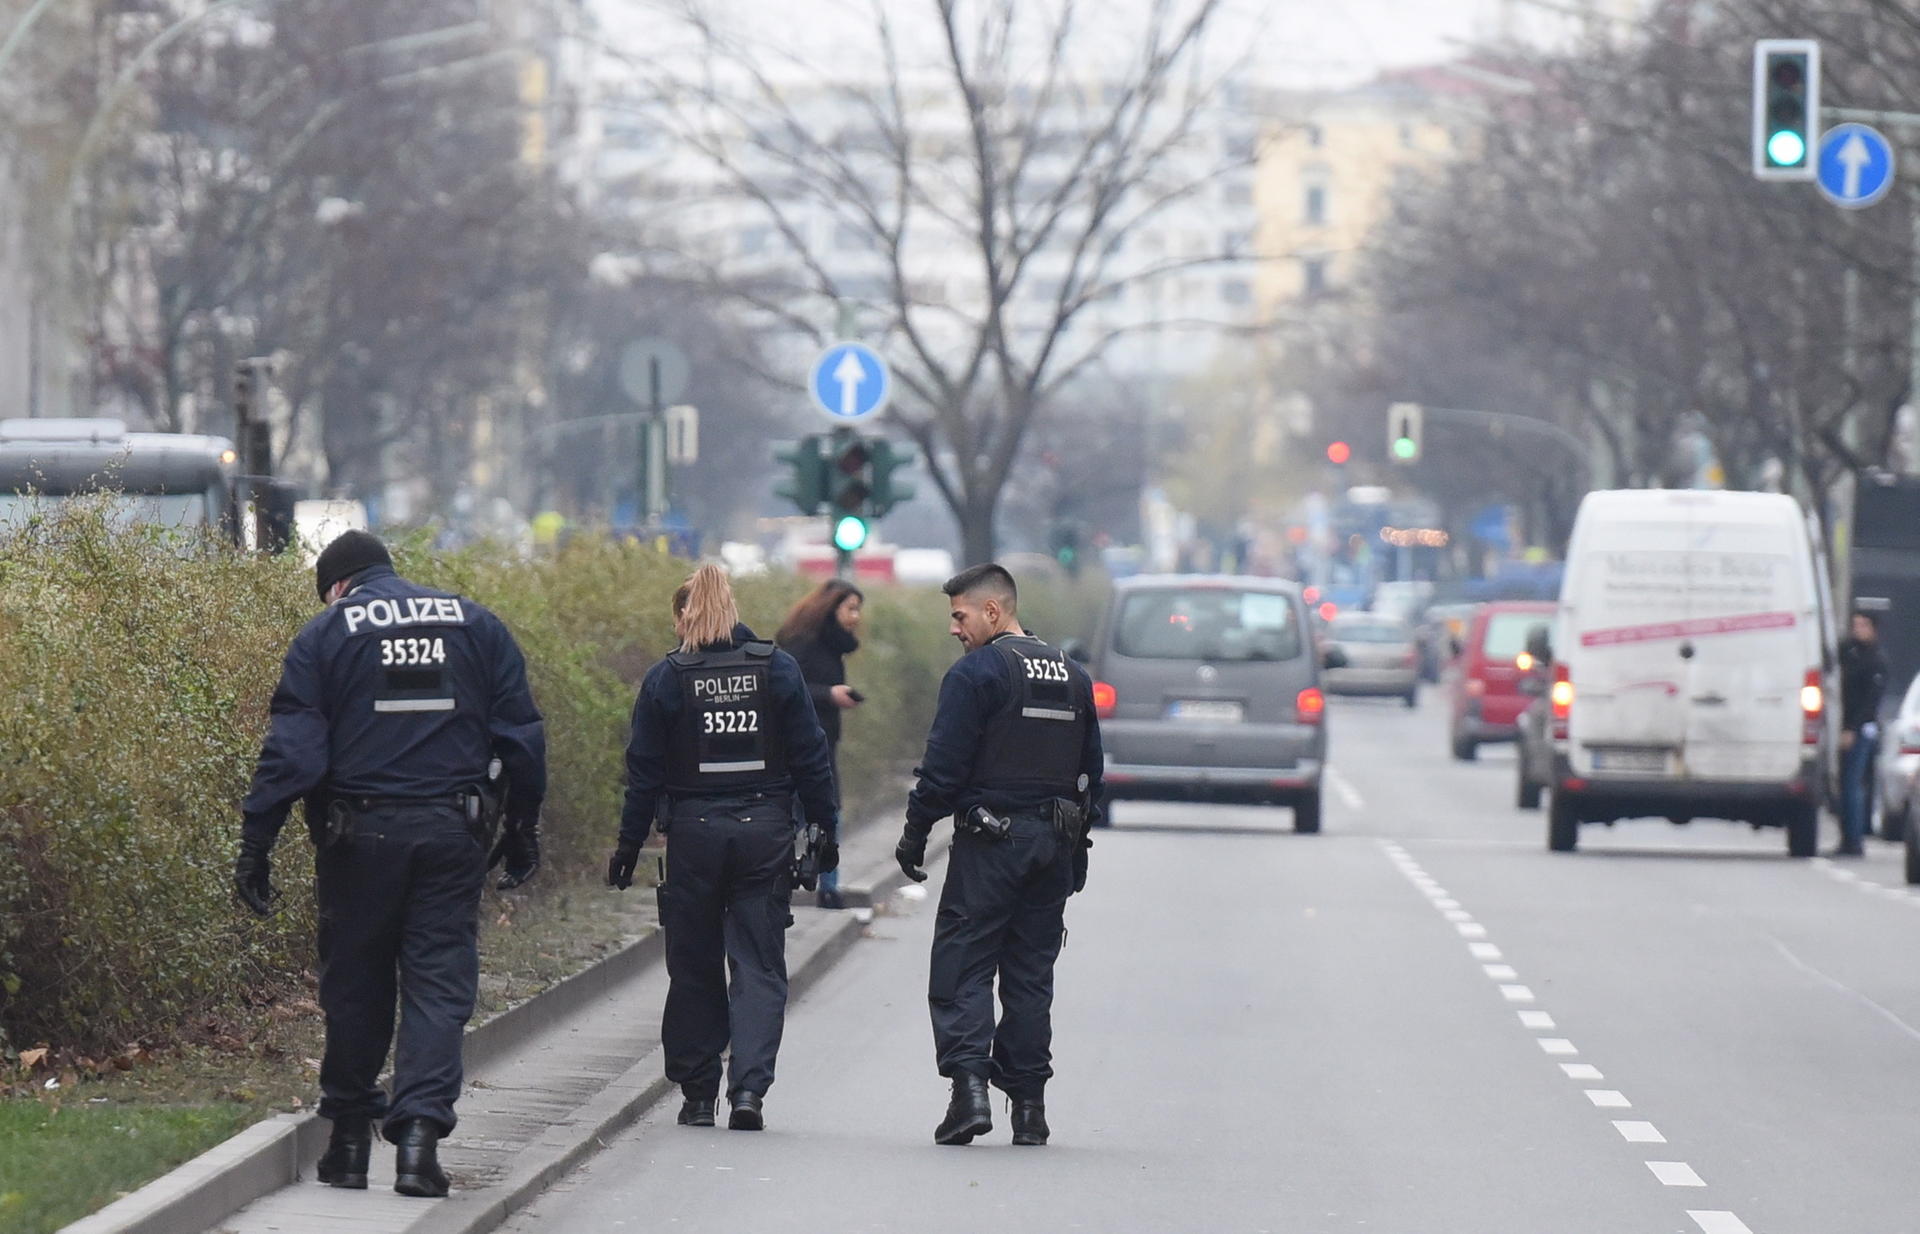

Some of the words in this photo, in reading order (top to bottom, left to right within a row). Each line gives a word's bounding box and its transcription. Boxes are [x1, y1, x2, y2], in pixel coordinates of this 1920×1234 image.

[344, 598, 465, 633] POLIZEI
[381, 637, 446, 665] 35324
[1023, 658, 1069, 682] 35215
[694, 674, 758, 696] POLIZEI
[714, 694, 740, 703] BERLIN
[703, 710, 758, 733] 35222
